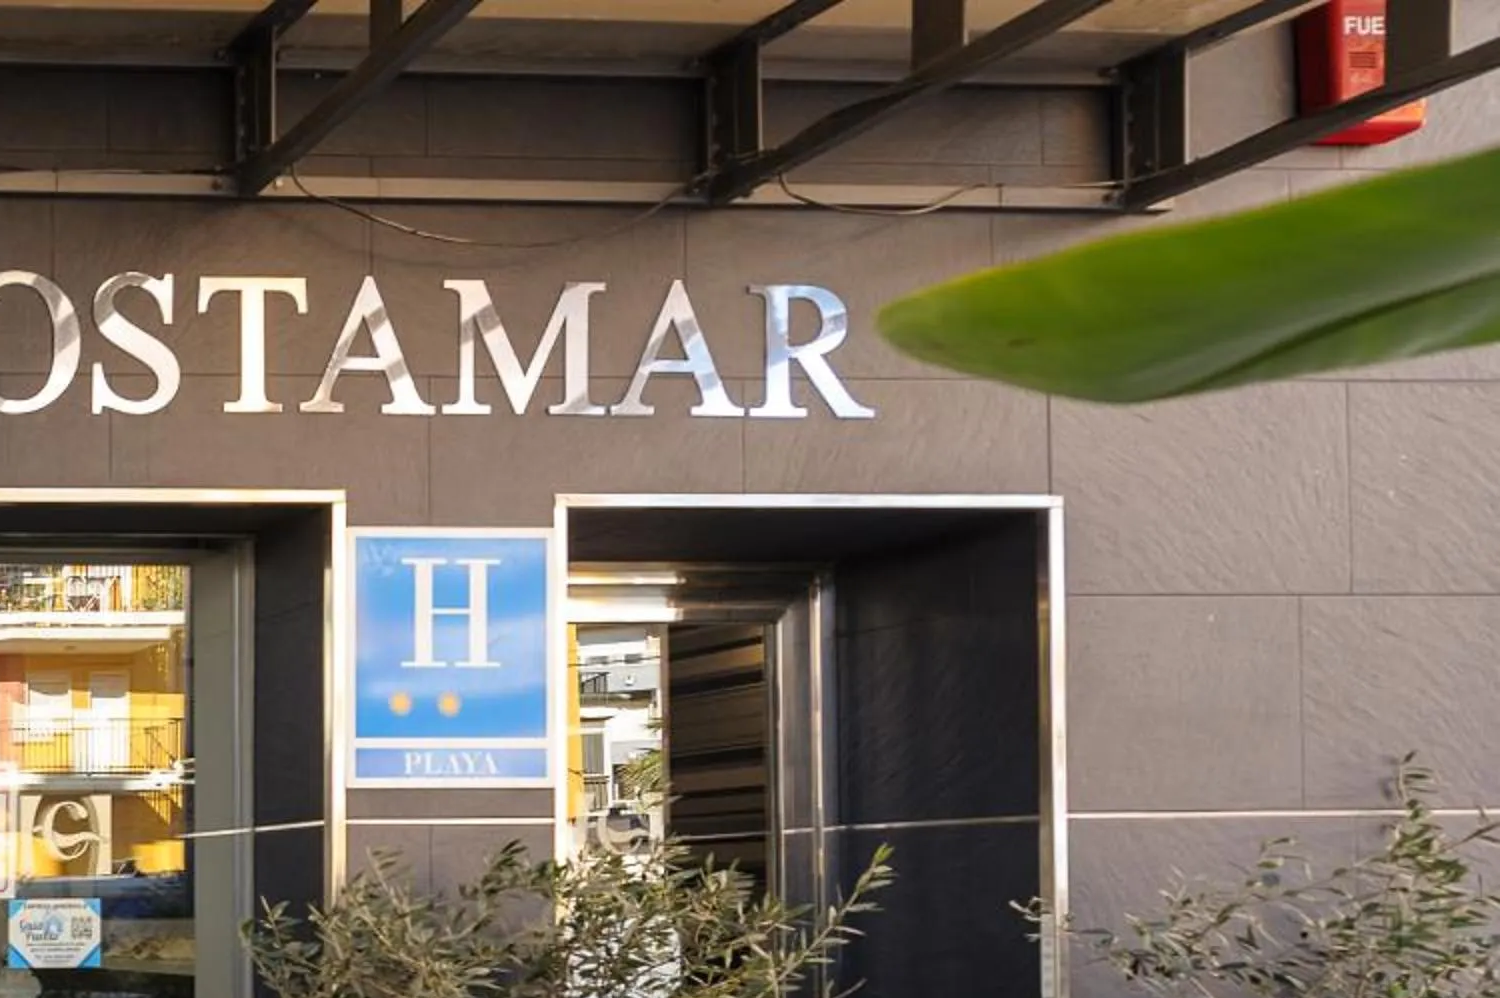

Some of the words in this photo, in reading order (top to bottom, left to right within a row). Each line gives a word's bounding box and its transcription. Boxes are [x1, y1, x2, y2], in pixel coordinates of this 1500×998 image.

[1343, 16, 1386, 35] FUE
[401, 558, 501, 668] H
[404, 751, 500, 775] PLAYA
